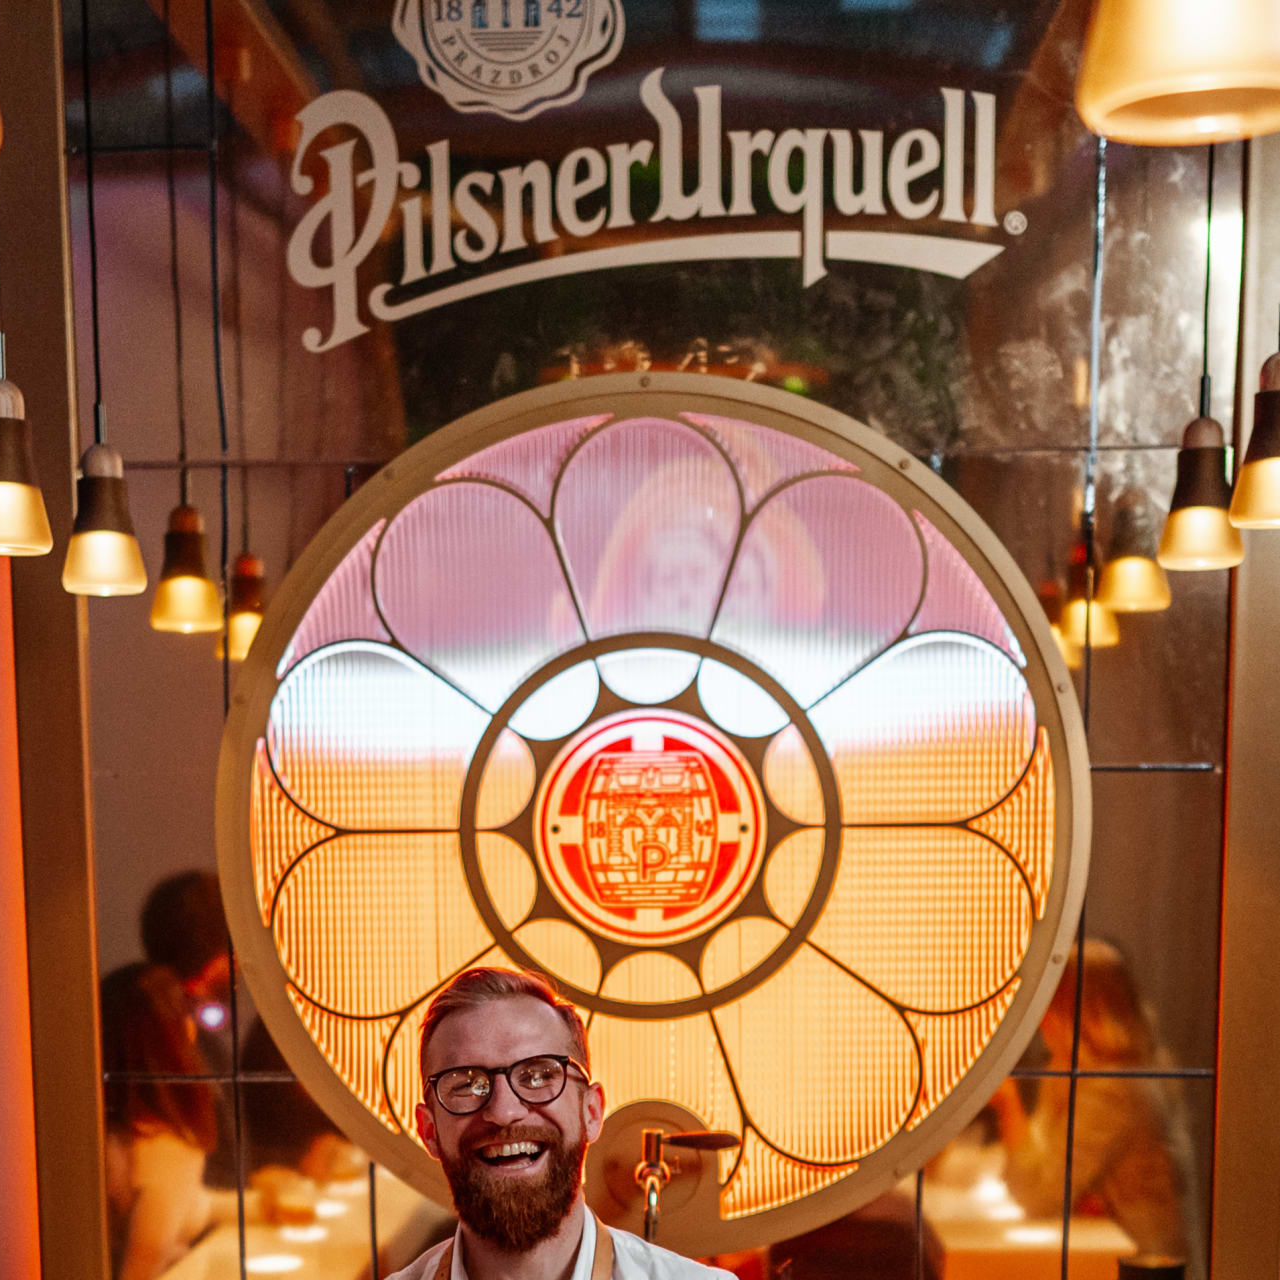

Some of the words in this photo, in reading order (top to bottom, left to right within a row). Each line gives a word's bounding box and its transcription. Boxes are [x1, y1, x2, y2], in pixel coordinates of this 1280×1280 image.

[434, 0, 463, 22] 18
[546, 0, 584, 19] 42
[287, 90, 655, 353] Pilsner
[640, 67, 999, 289] Urquell
[589, 821, 606, 839] 18
[638, 841, 670, 882] P
